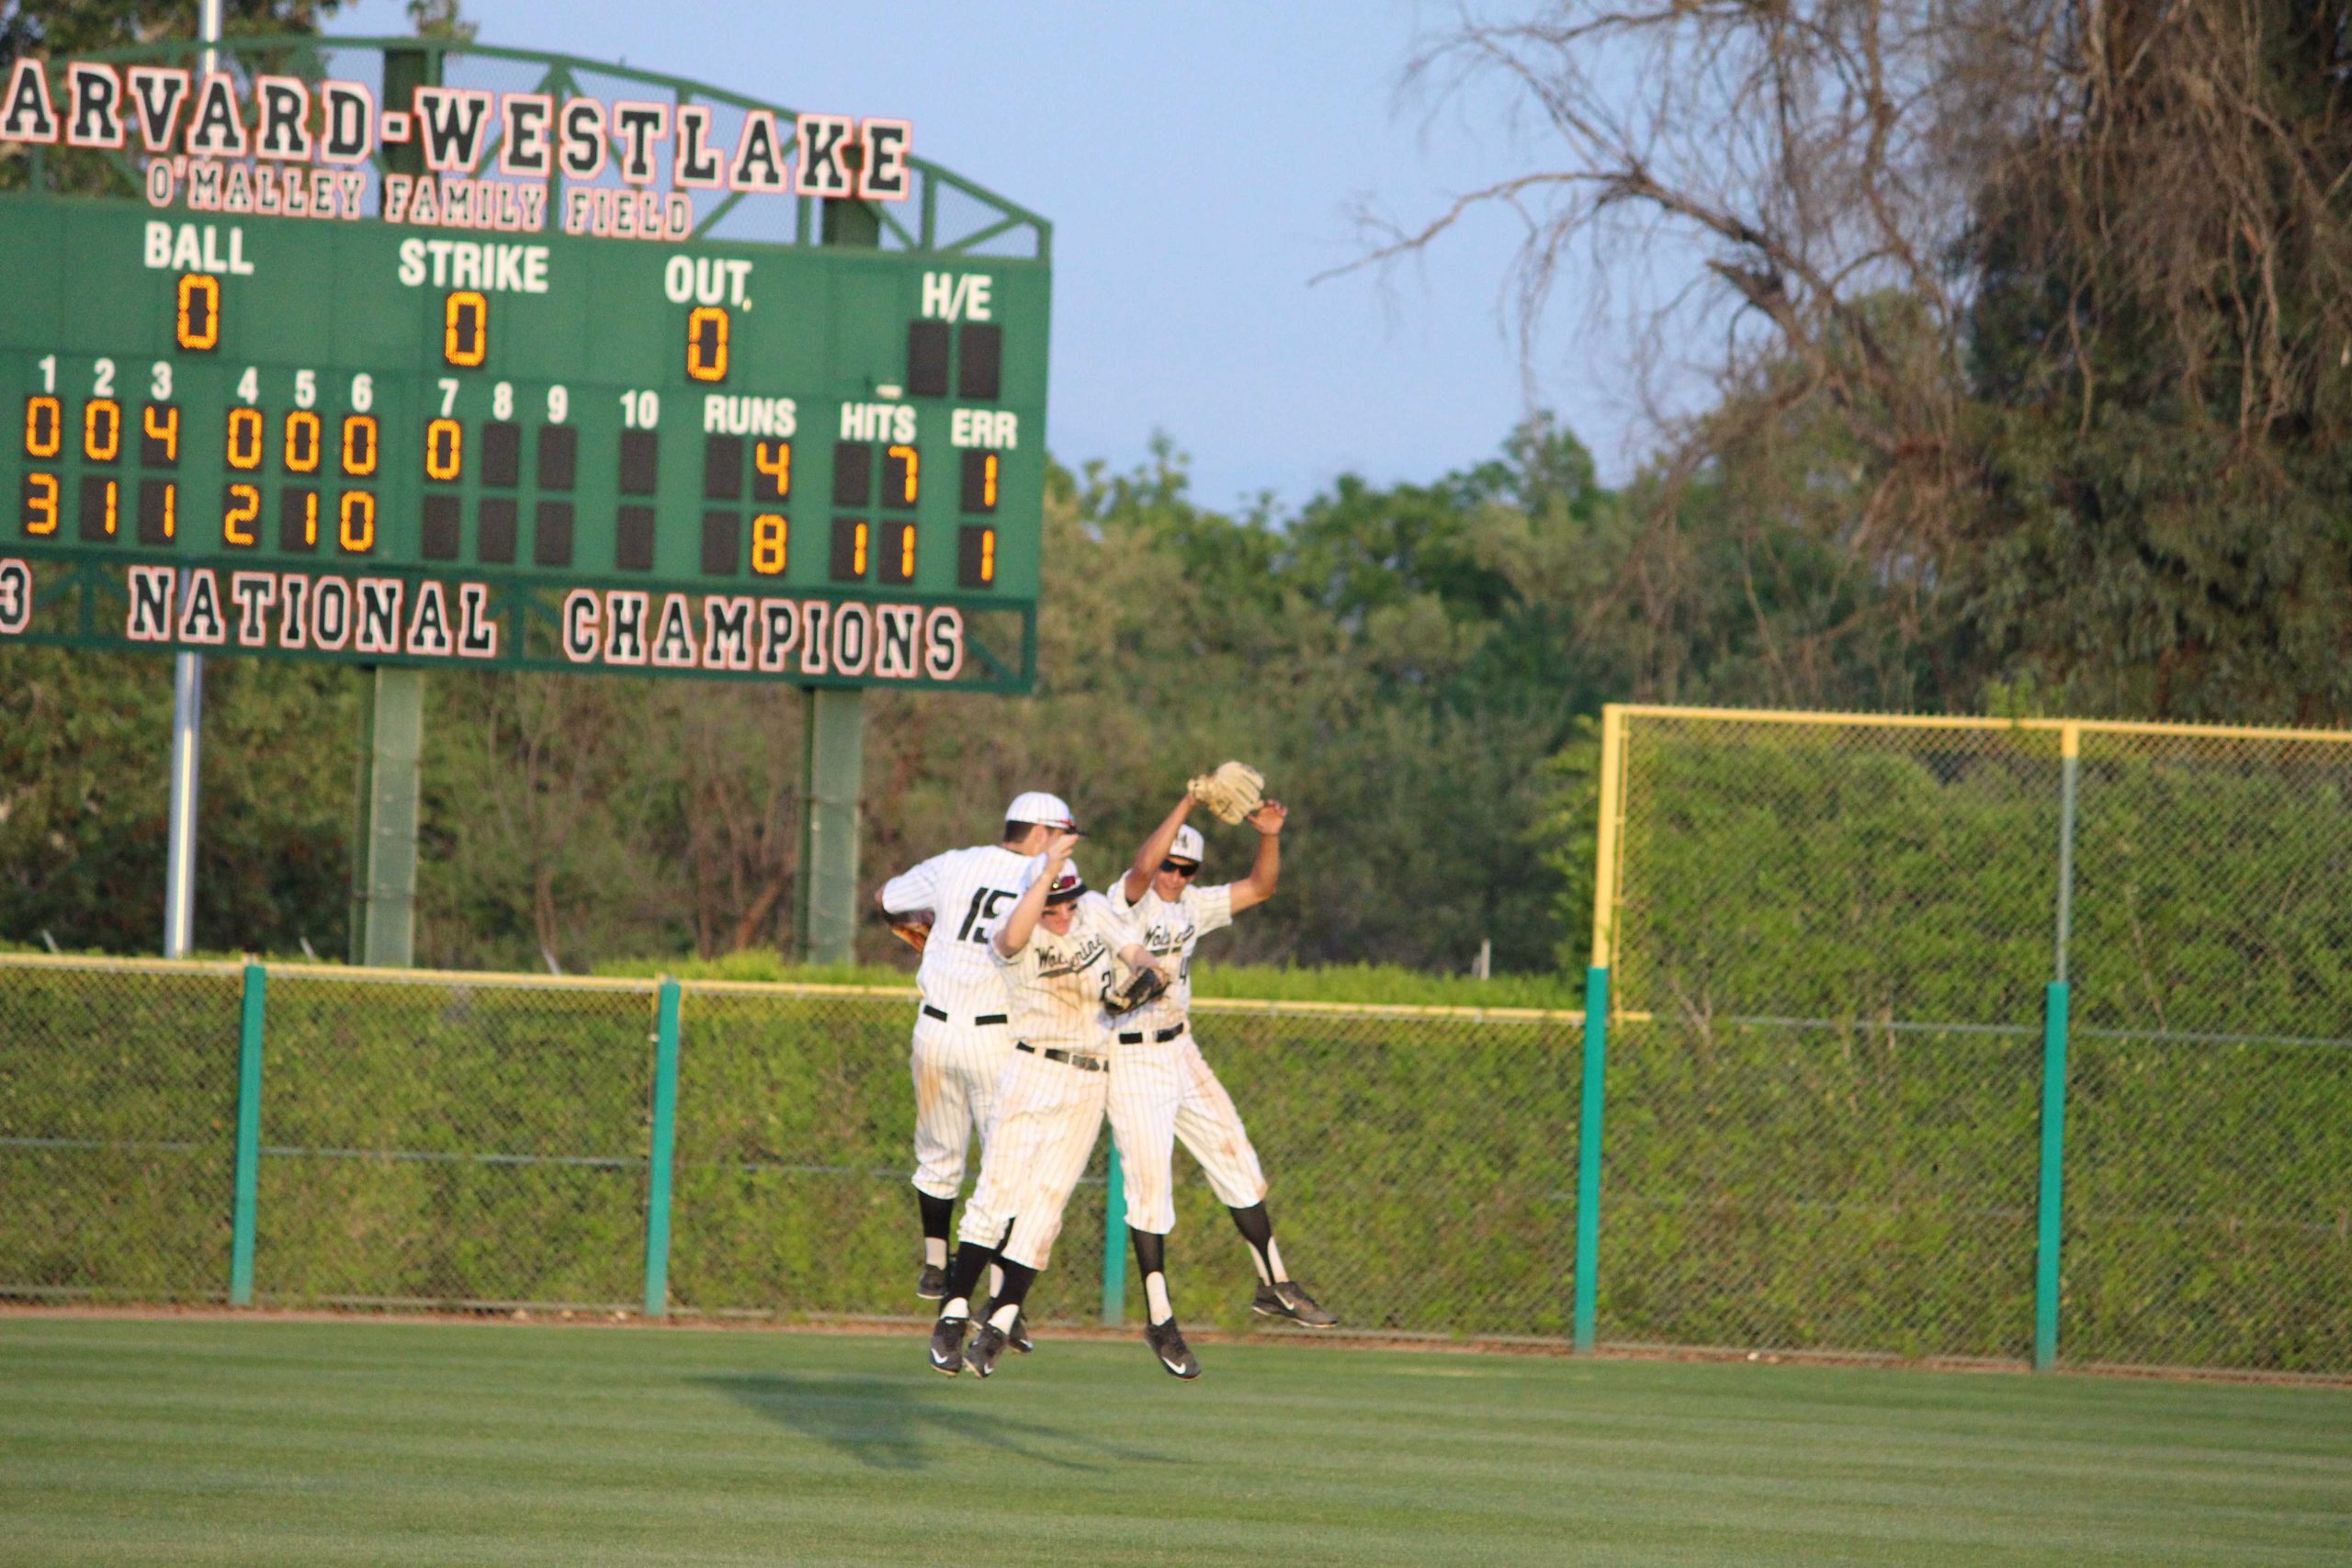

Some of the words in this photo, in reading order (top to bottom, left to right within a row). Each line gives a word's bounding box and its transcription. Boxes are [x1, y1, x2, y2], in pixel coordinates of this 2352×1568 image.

[0, 57, 911, 201] ARVARD-WESTLAKE
[146, 156, 368, 220] O'MALLEY
[383, 172, 549, 232] FAMILY
[565, 186, 693, 242] FIELD
[143, 220, 254, 275] BALL
[398, 237, 550, 294] STRIKE
[177, 273, 220, 350] 0
[445, 290, 487, 367] 0
[921, 271, 993, 322] H/E
[687, 307, 729, 382] 0
[39, 355, 56, 393] 1
[93, 357, 115, 397] 2
[151, 361, 172, 400] 3
[236, 366, 259, 405] 4
[294, 368, 316, 409] 5
[351, 373, 373, 412] 6
[437, 378, 459, 418] 7
[492, 381, 514, 421] 8
[547, 384, 569, 424] 9
[619, 389, 660, 430] 10
[703, 393, 797, 437] RUNS
[840, 401, 917, 445] HITS
[950, 408, 1019, 450] ERR
[26, 396, 61, 457] 0
[85, 399, 120, 461] 0
[143, 406, 178, 460] 4
[227, 408, 263, 469] 0
[285, 411, 321, 472] 0
[342, 415, 378, 476] 0
[426, 418, 462, 480] 0
[755, 442, 790, 495] 4
[888, 445, 919, 502] 7
[984, 455, 998, 507] 1
[27, 472, 59, 535] 3
[105, 480, 118, 535] 1
[164, 484, 175, 537] 1
[224, 484, 260, 546] 2
[305, 491, 318, 545] 1
[340, 491, 375, 552] 0
[752, 513, 787, 574] 8
[980, 529, 995, 581] 1
[127, 564, 499, 660] NATIONAL
[561, 587, 965, 682] CHAMPIONS
